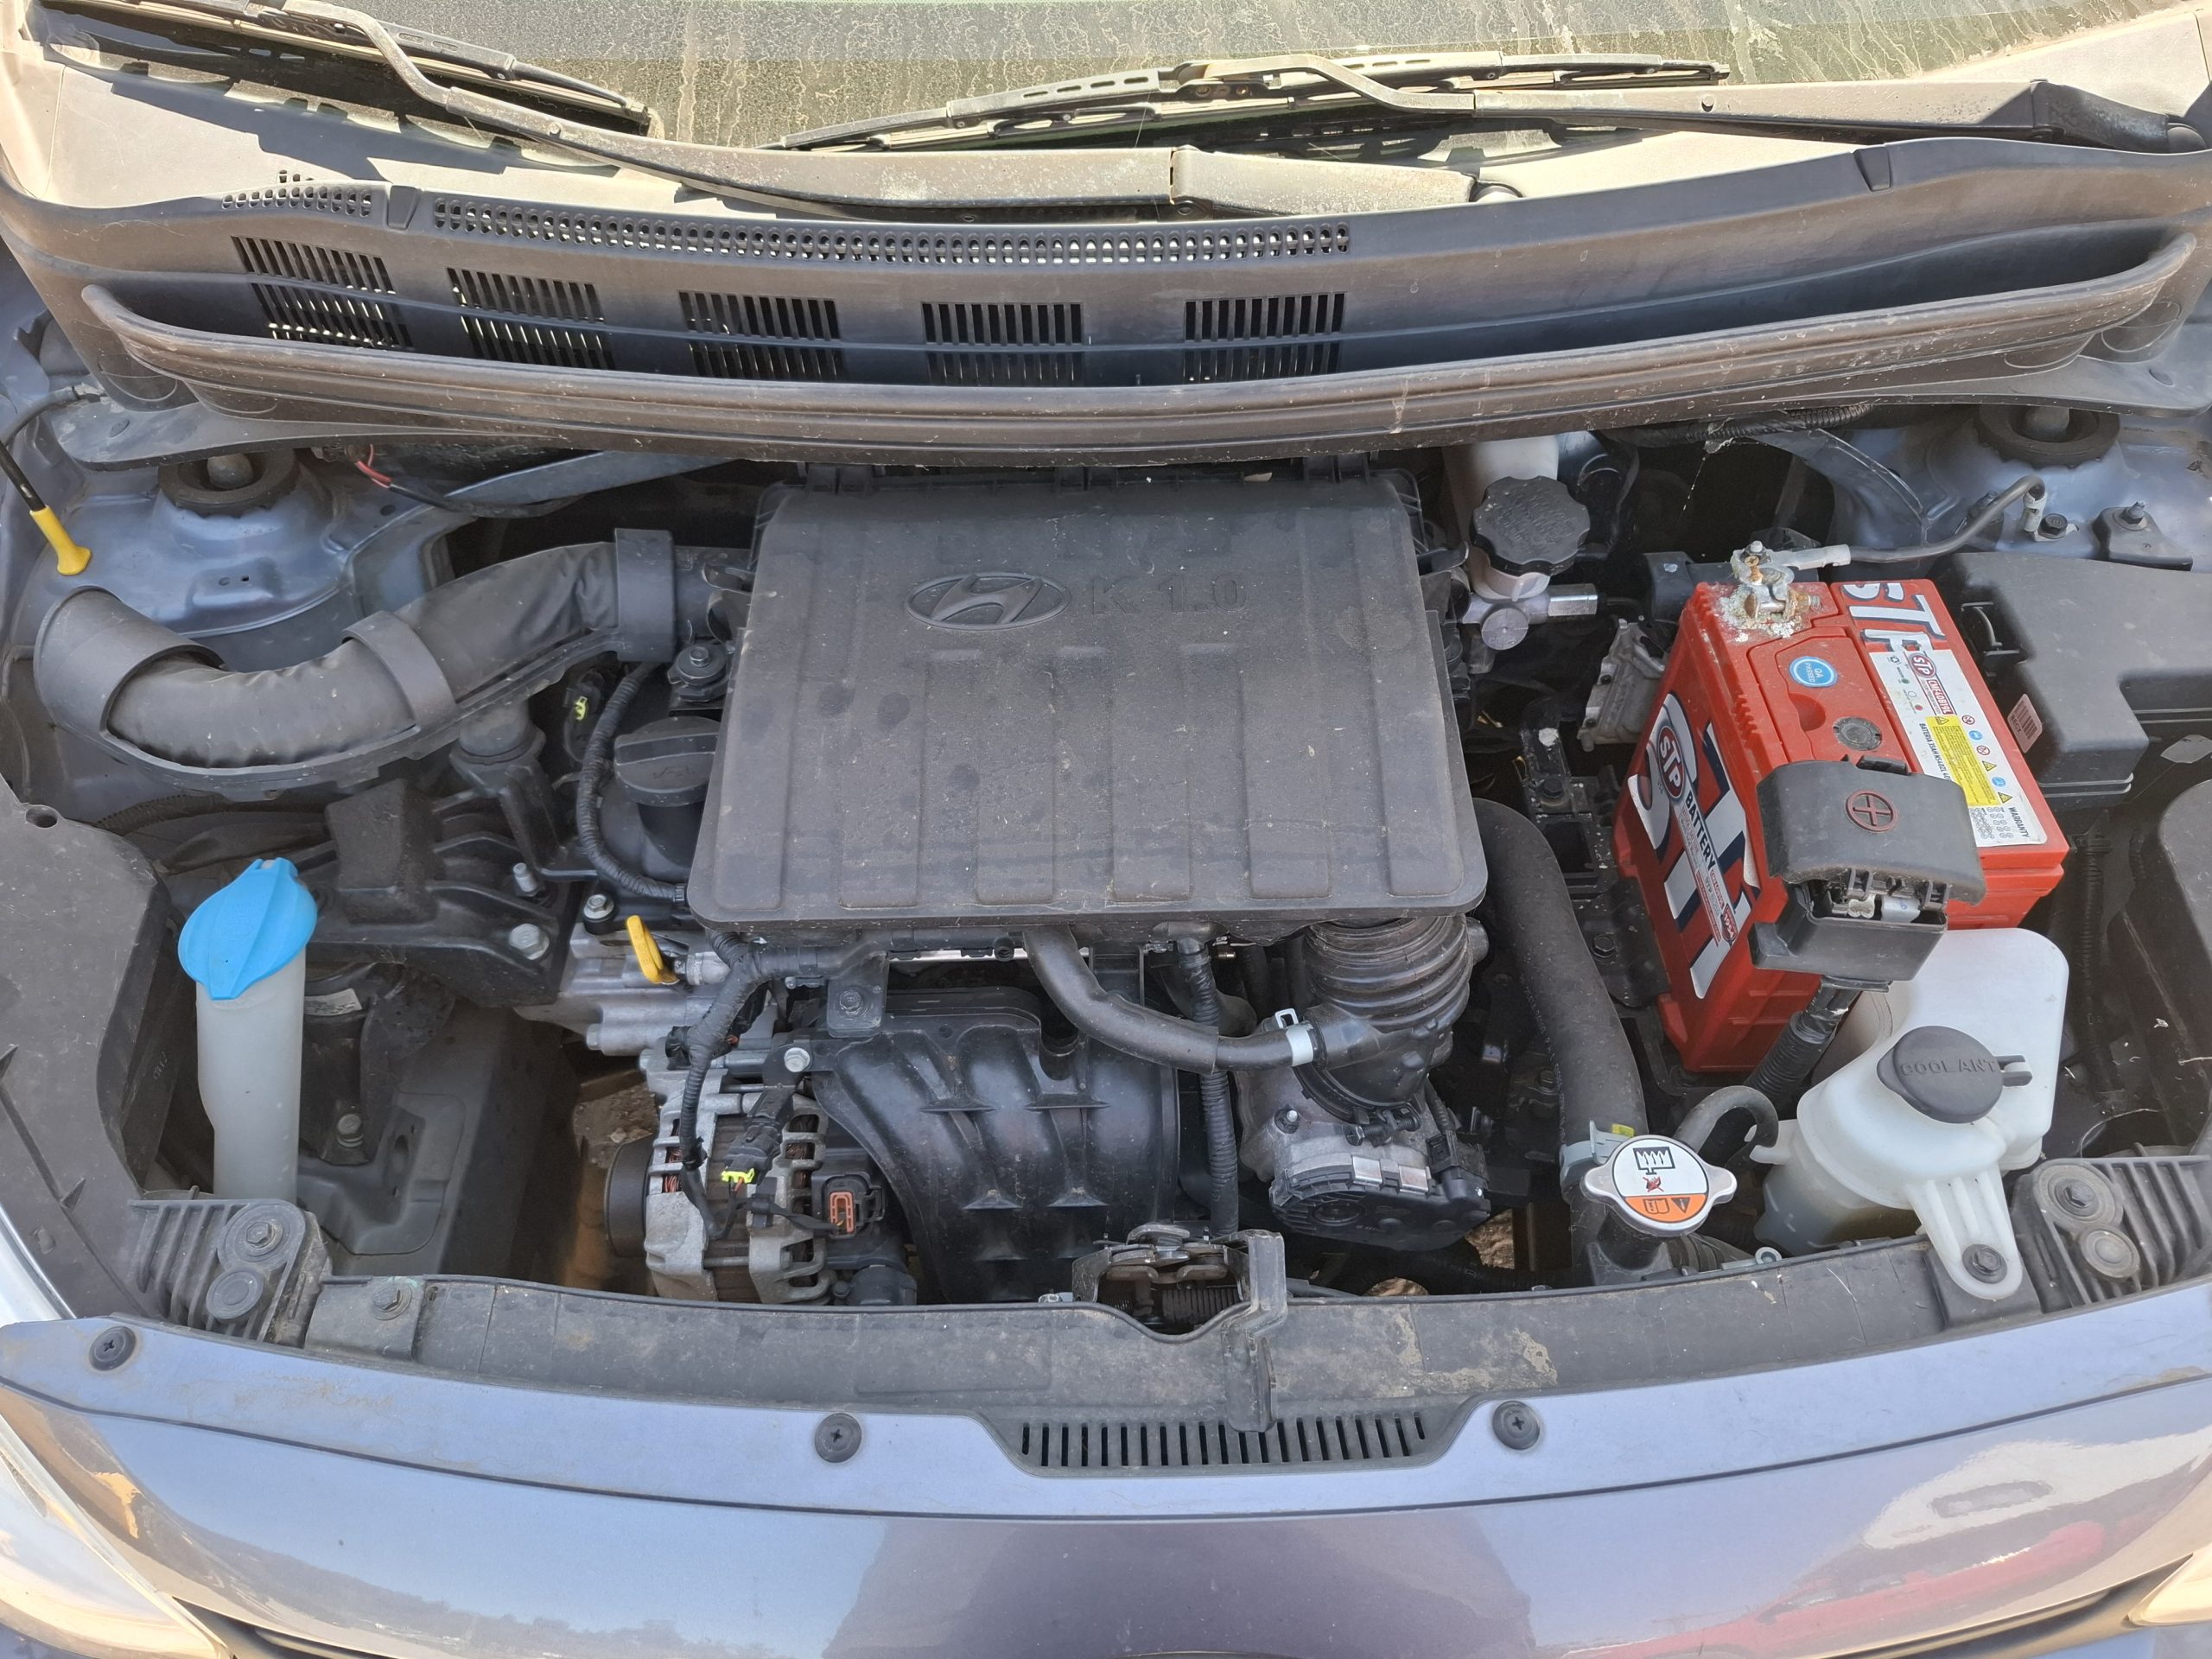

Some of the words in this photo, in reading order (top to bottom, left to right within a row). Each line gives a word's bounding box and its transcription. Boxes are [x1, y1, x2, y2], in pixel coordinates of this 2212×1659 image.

[1092, 575, 1141, 615] K
[1158, 572, 1249, 613] 1.0
[1803, 662, 1816, 683] PASSED
[1815, 668, 1824, 678] QA
[1911, 654, 1934, 676] STP
[1919, 722, 1931, 745] BATERIA
[1658, 734, 1682, 791] STP
[1685, 791, 1716, 871] BATTERY
[2008, 806, 2030, 838] WARRANTY
[1900, 1058, 1999, 1077] COOLANT
